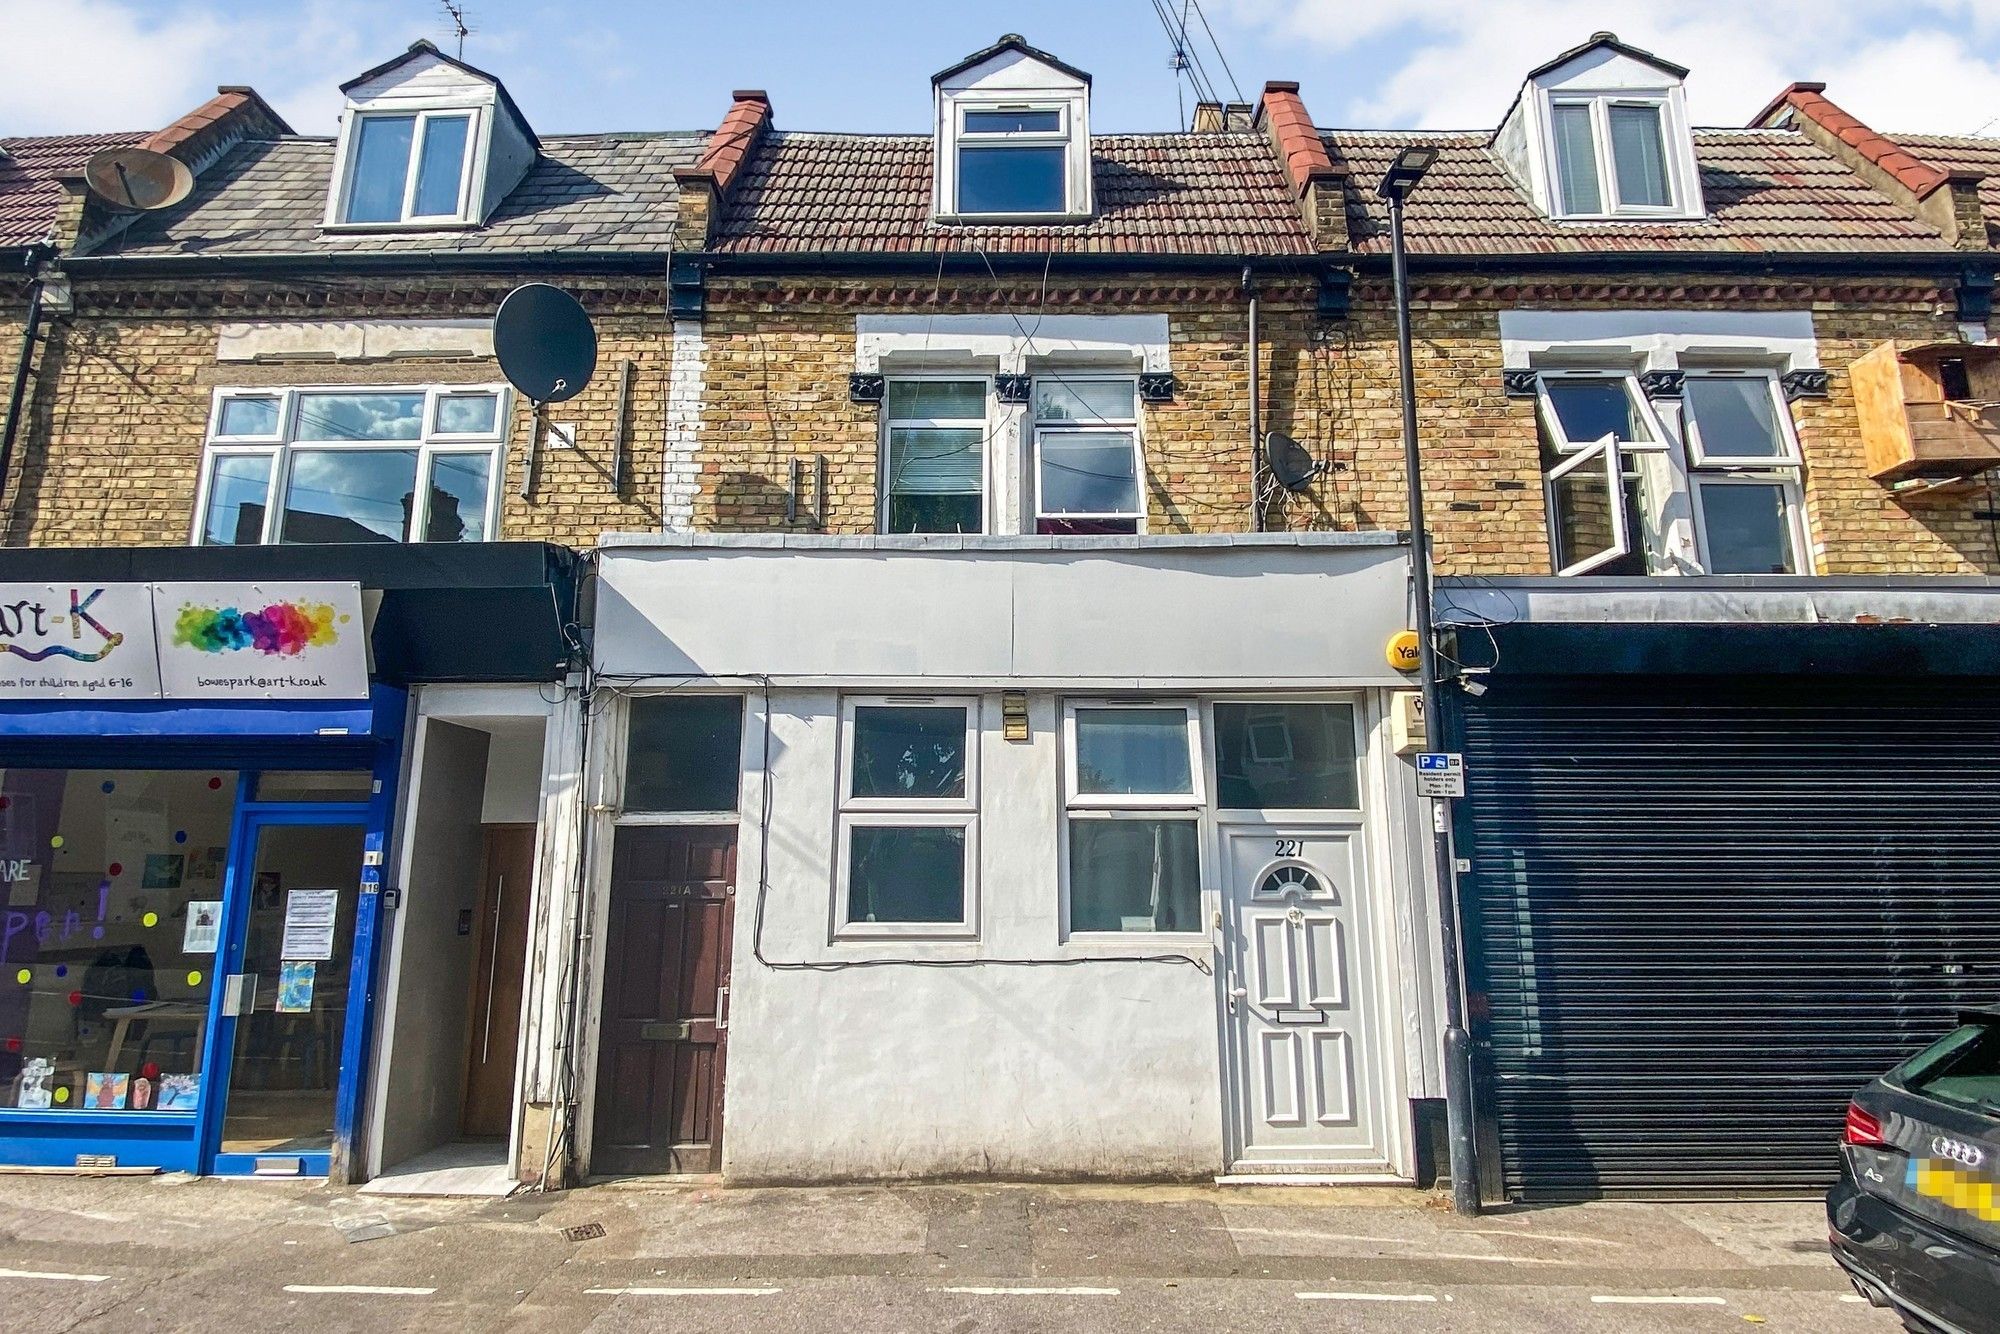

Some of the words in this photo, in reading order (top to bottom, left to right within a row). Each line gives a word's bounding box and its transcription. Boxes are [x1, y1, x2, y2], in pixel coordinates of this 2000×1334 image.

[20, 677, 37, 688] for
[39, 677, 79, 688] children
[82, 678, 106, 691] aged
[108, 678, 133, 687] 6-16
[1421, 756, 1431, 768] P
[1274, 840, 1304, 857] 221
[1864, 1168, 1884, 1183] A3
